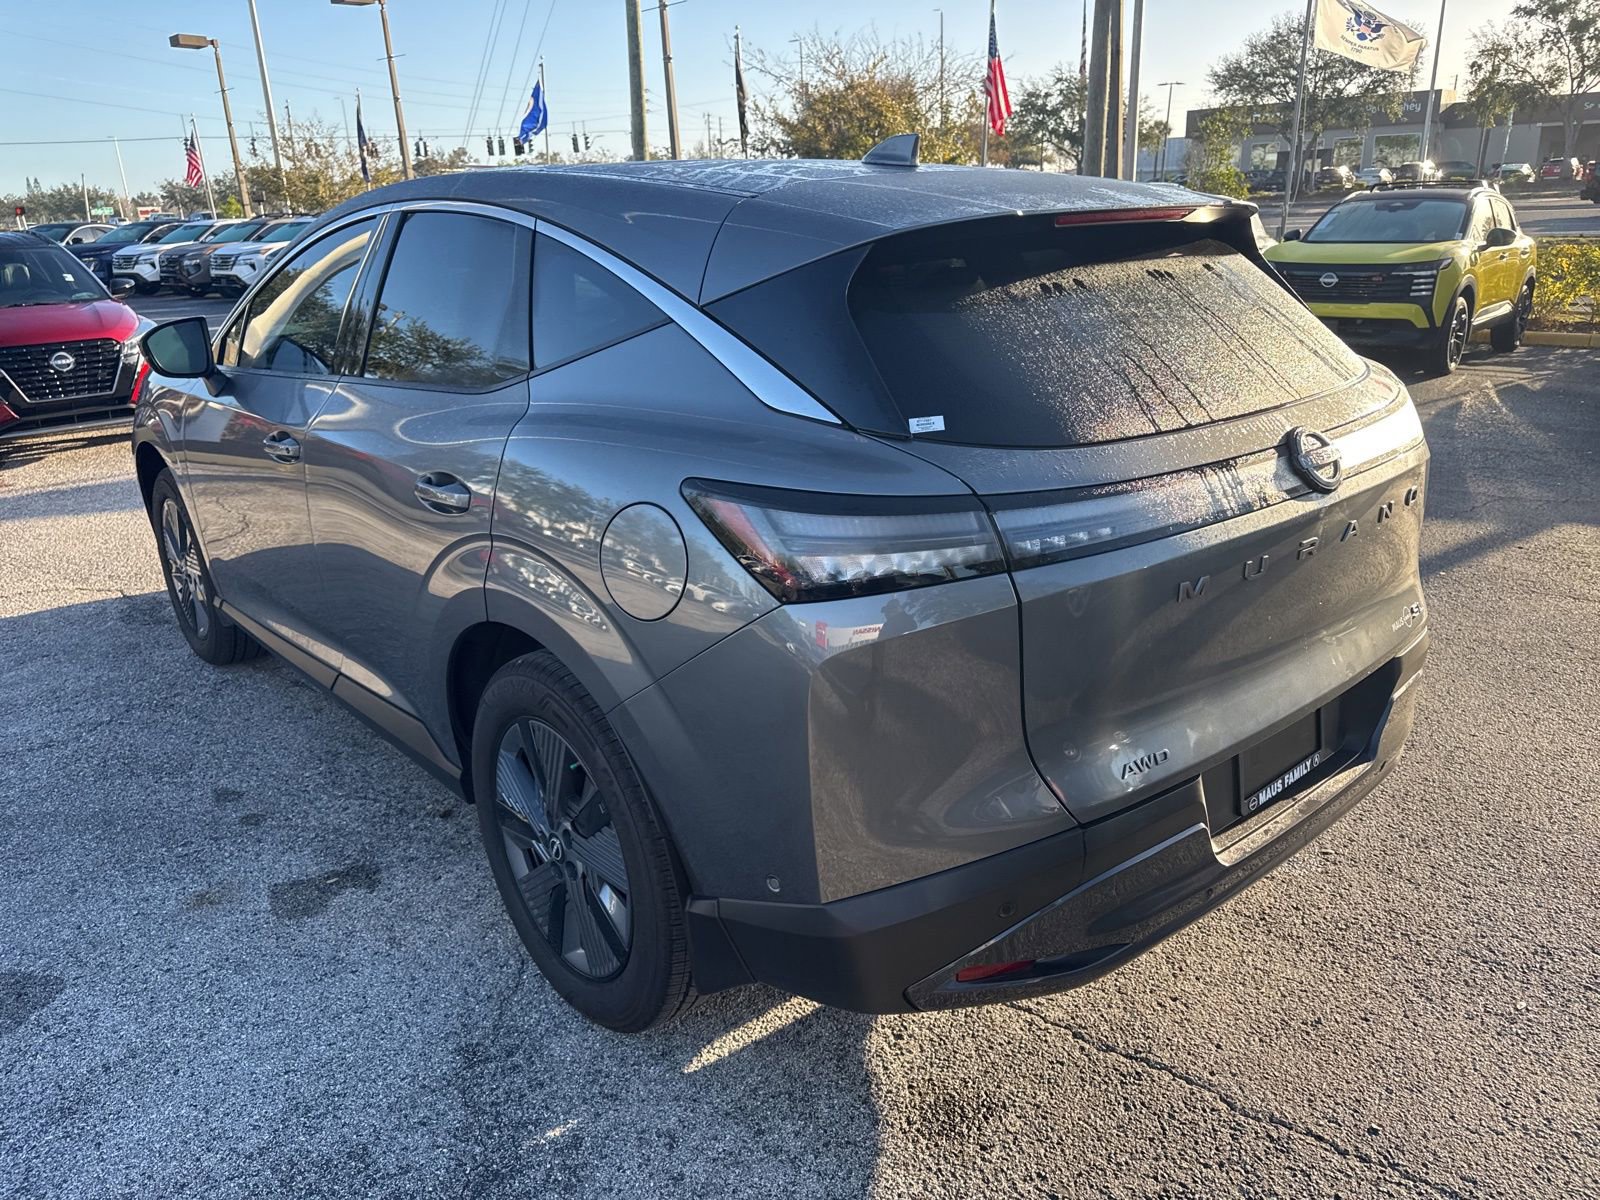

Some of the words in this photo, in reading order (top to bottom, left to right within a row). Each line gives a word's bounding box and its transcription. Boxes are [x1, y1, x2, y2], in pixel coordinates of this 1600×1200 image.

[1340, 34, 1357, 47] SEMPER
[1177, 486, 1417, 602] MURANO
[1121, 749, 1170, 780] AWD
[1258, 780, 1282, 805] MAUS
[1284, 759, 1311, 788] FAMILY
